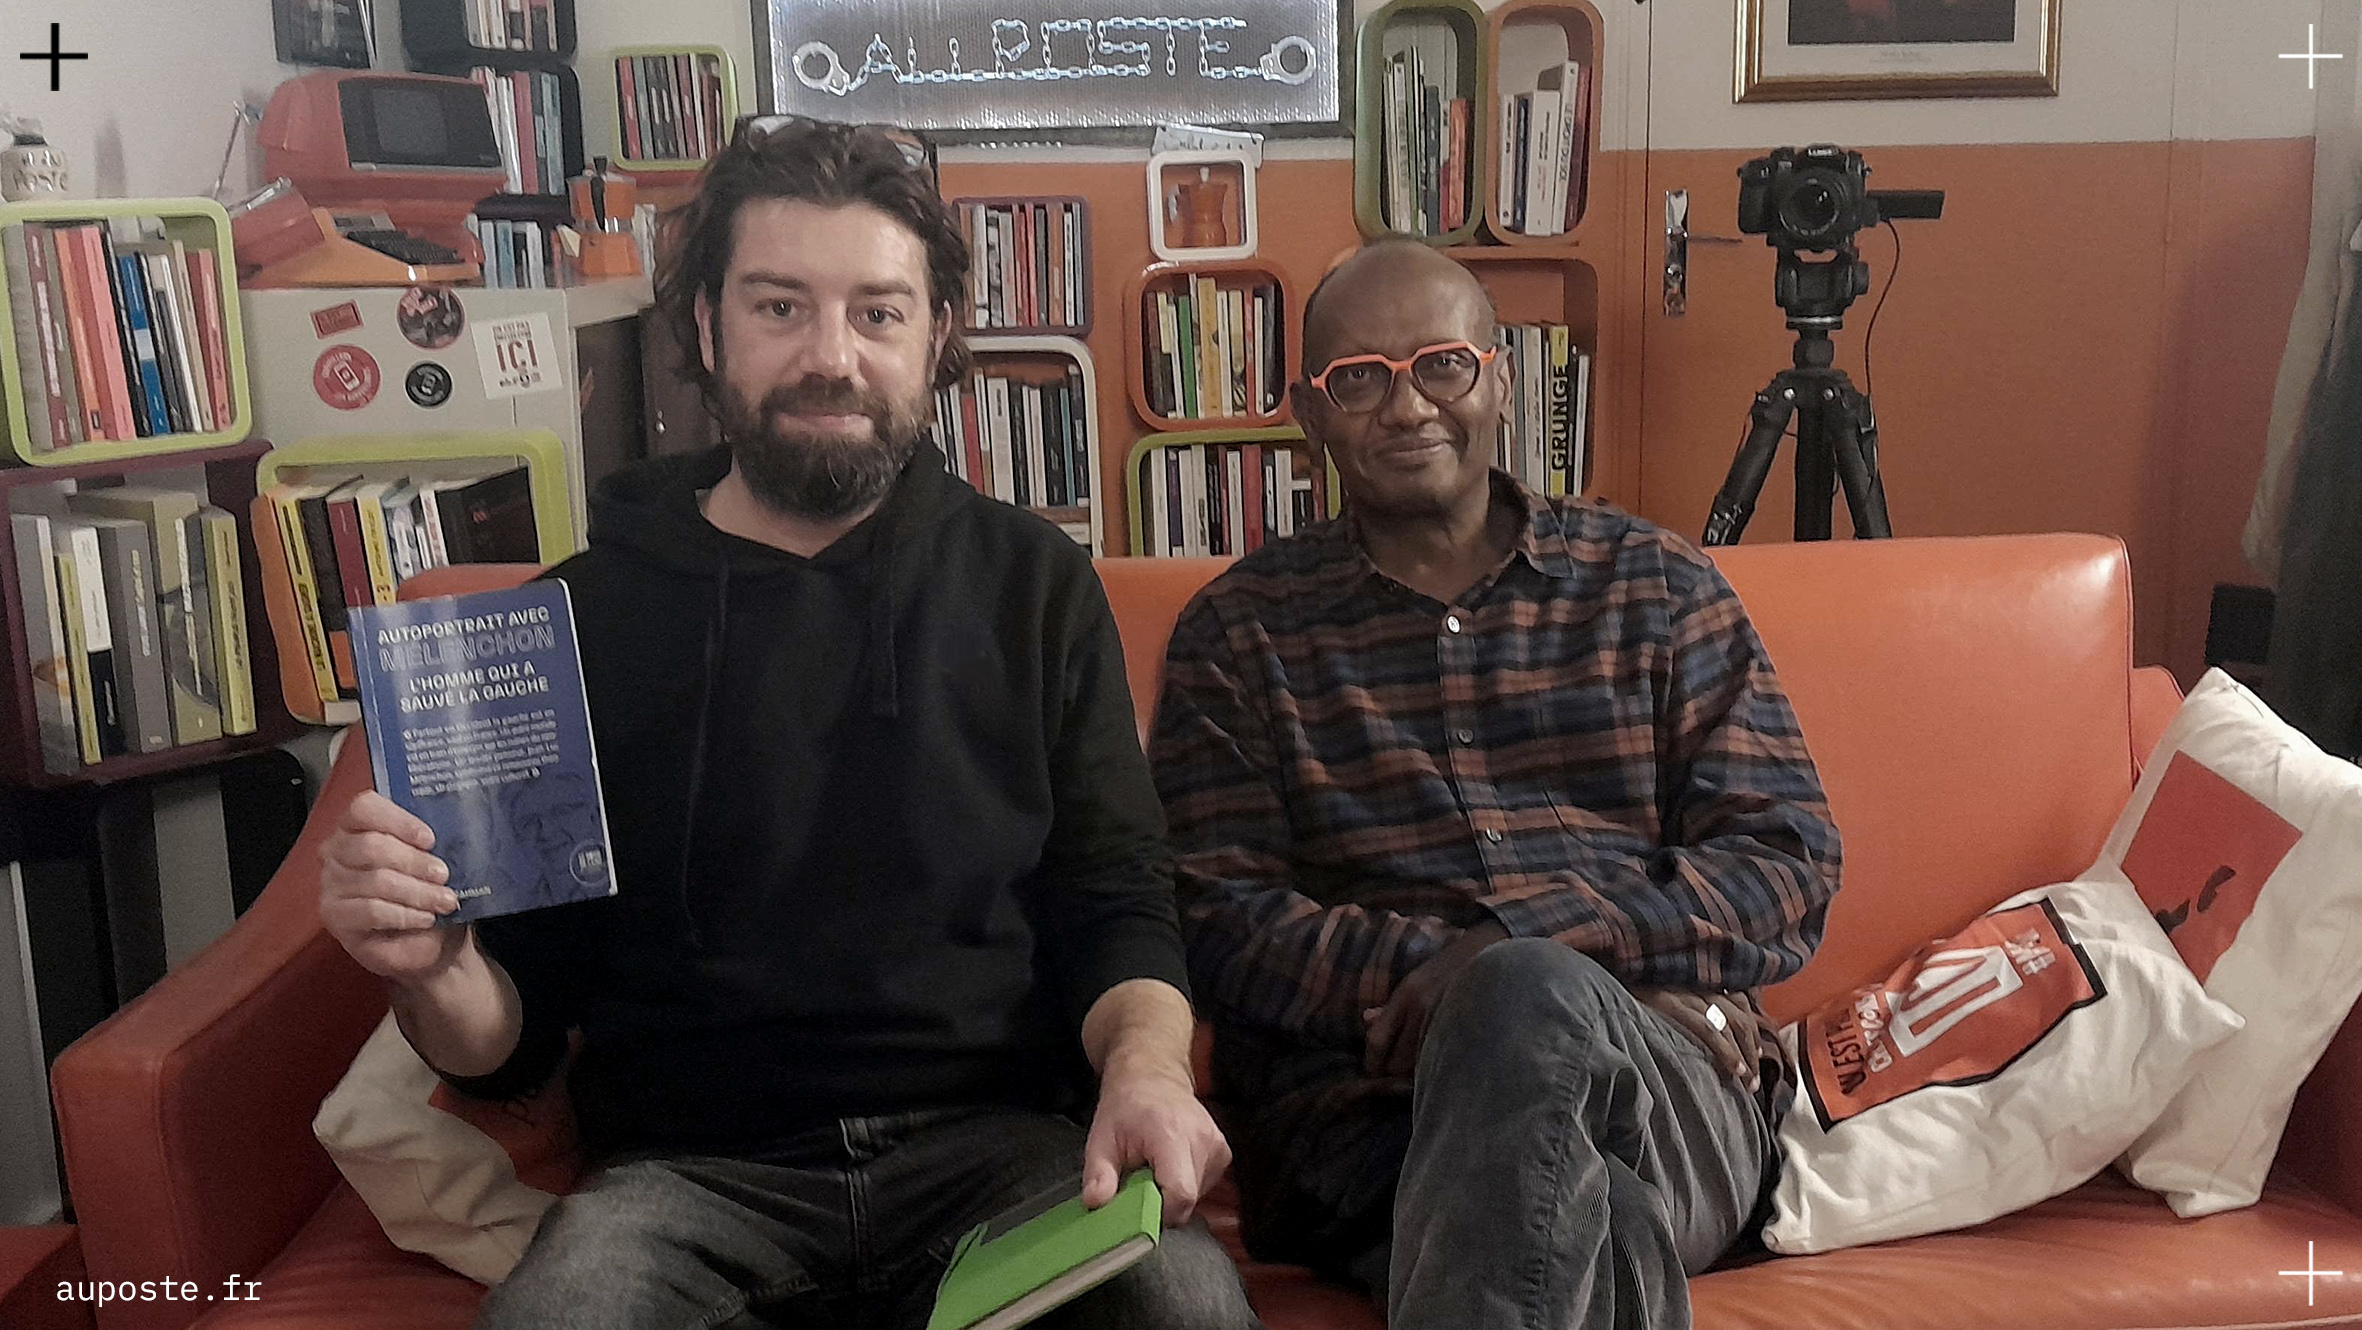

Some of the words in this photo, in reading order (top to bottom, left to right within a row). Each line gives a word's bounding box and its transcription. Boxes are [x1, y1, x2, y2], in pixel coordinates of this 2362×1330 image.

[496, 340, 539, 373] ICI
[1551, 364, 1569, 471] GRUNGE
[378, 612, 504, 645] AUTOPORTRAIT
[508, 605, 550, 627] AVEC
[409, 666, 486, 694] L'HOMME
[487, 662, 521, 682] QUI
[523, 660, 536, 678] A
[459, 687, 481, 706] LA
[482, 675, 549, 701] GAUCHE
